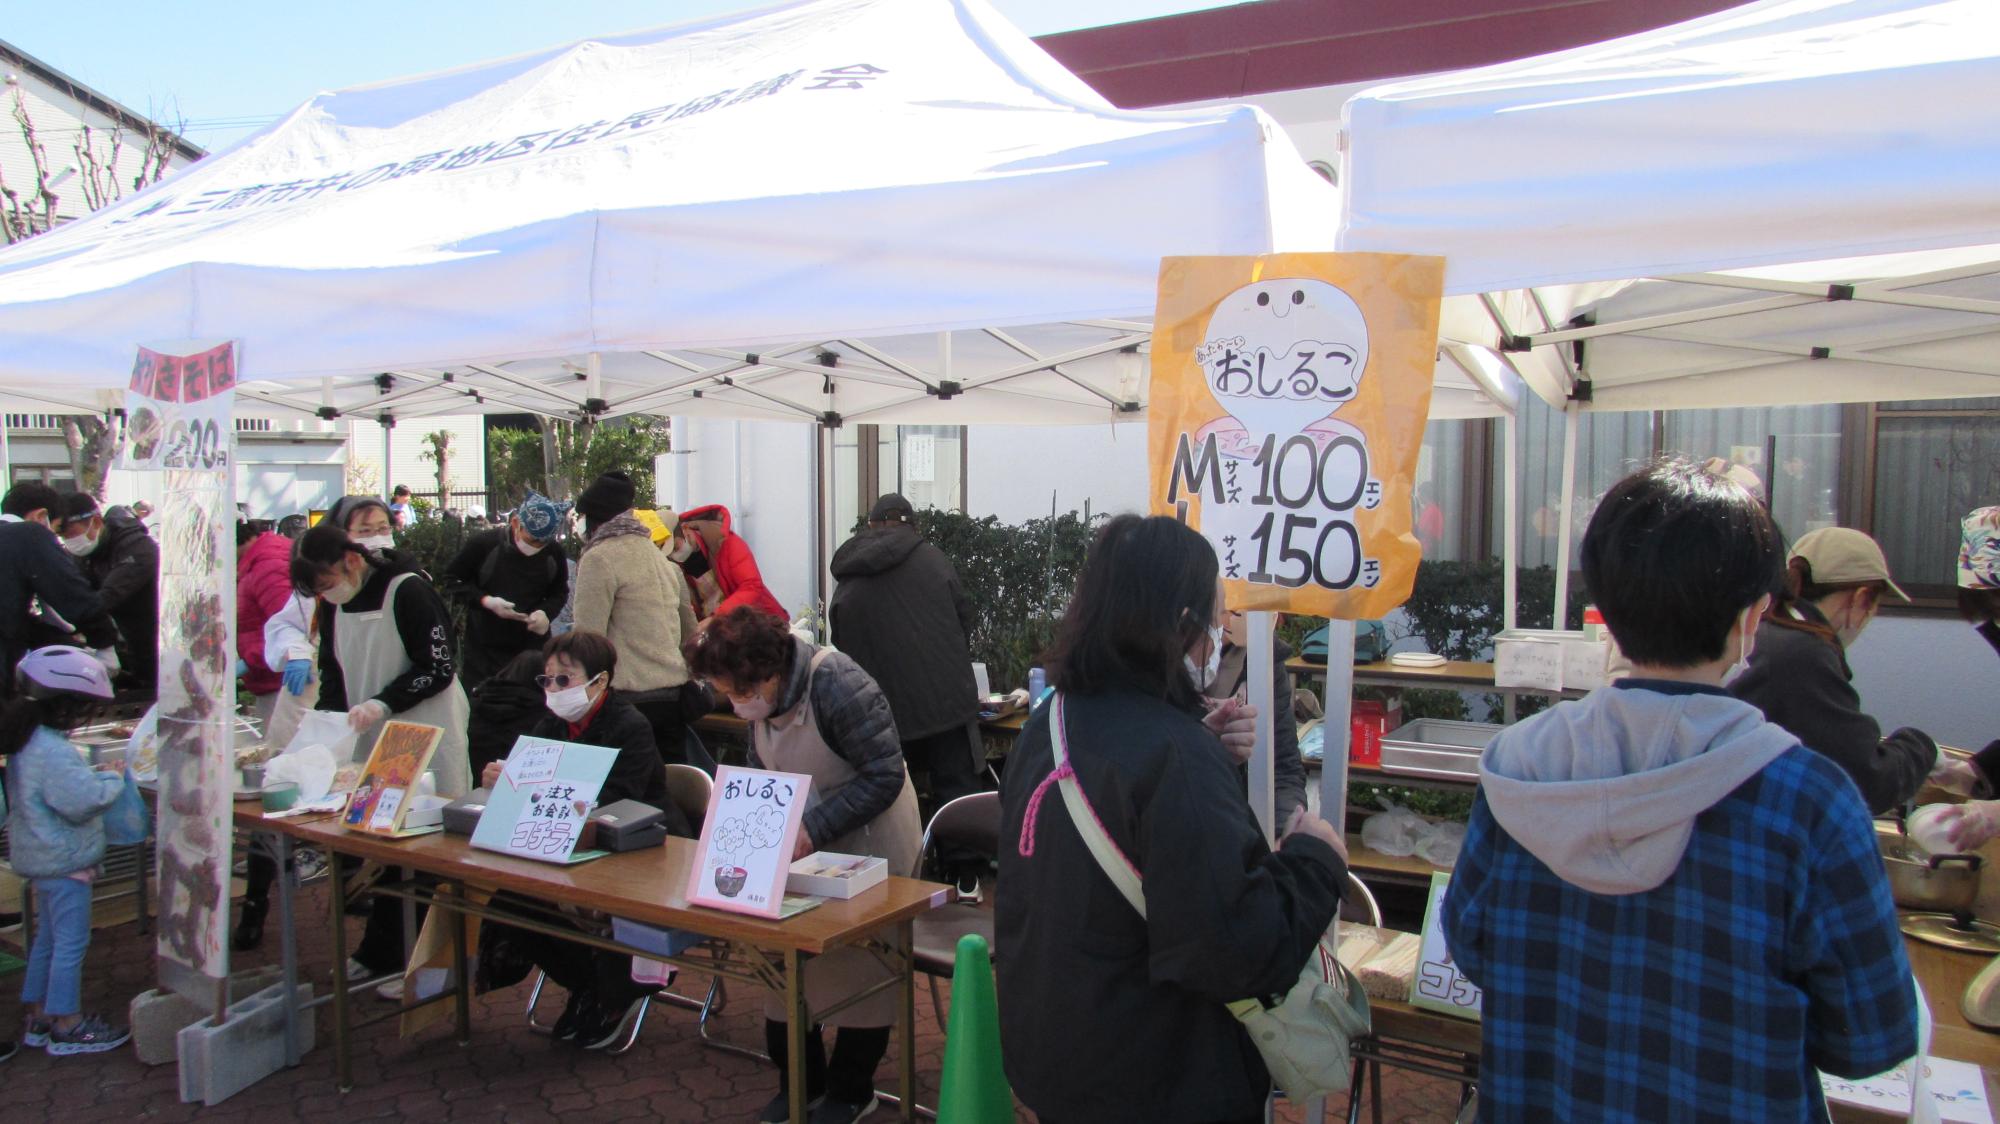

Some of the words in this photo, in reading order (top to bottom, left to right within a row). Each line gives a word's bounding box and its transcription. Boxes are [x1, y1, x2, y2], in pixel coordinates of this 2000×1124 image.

[1215, 349, 1353, 398] おしるこ
[1167, 432, 1226, 504] M
[1250, 433, 1368, 511] 100
[1248, 512, 1361, 589] 150
[544, 786, 576, 801] 注文
[724, 777, 793, 807] おしるこ
[532, 803, 571, 820] お会計
[510, 820, 572, 855] コチラ
